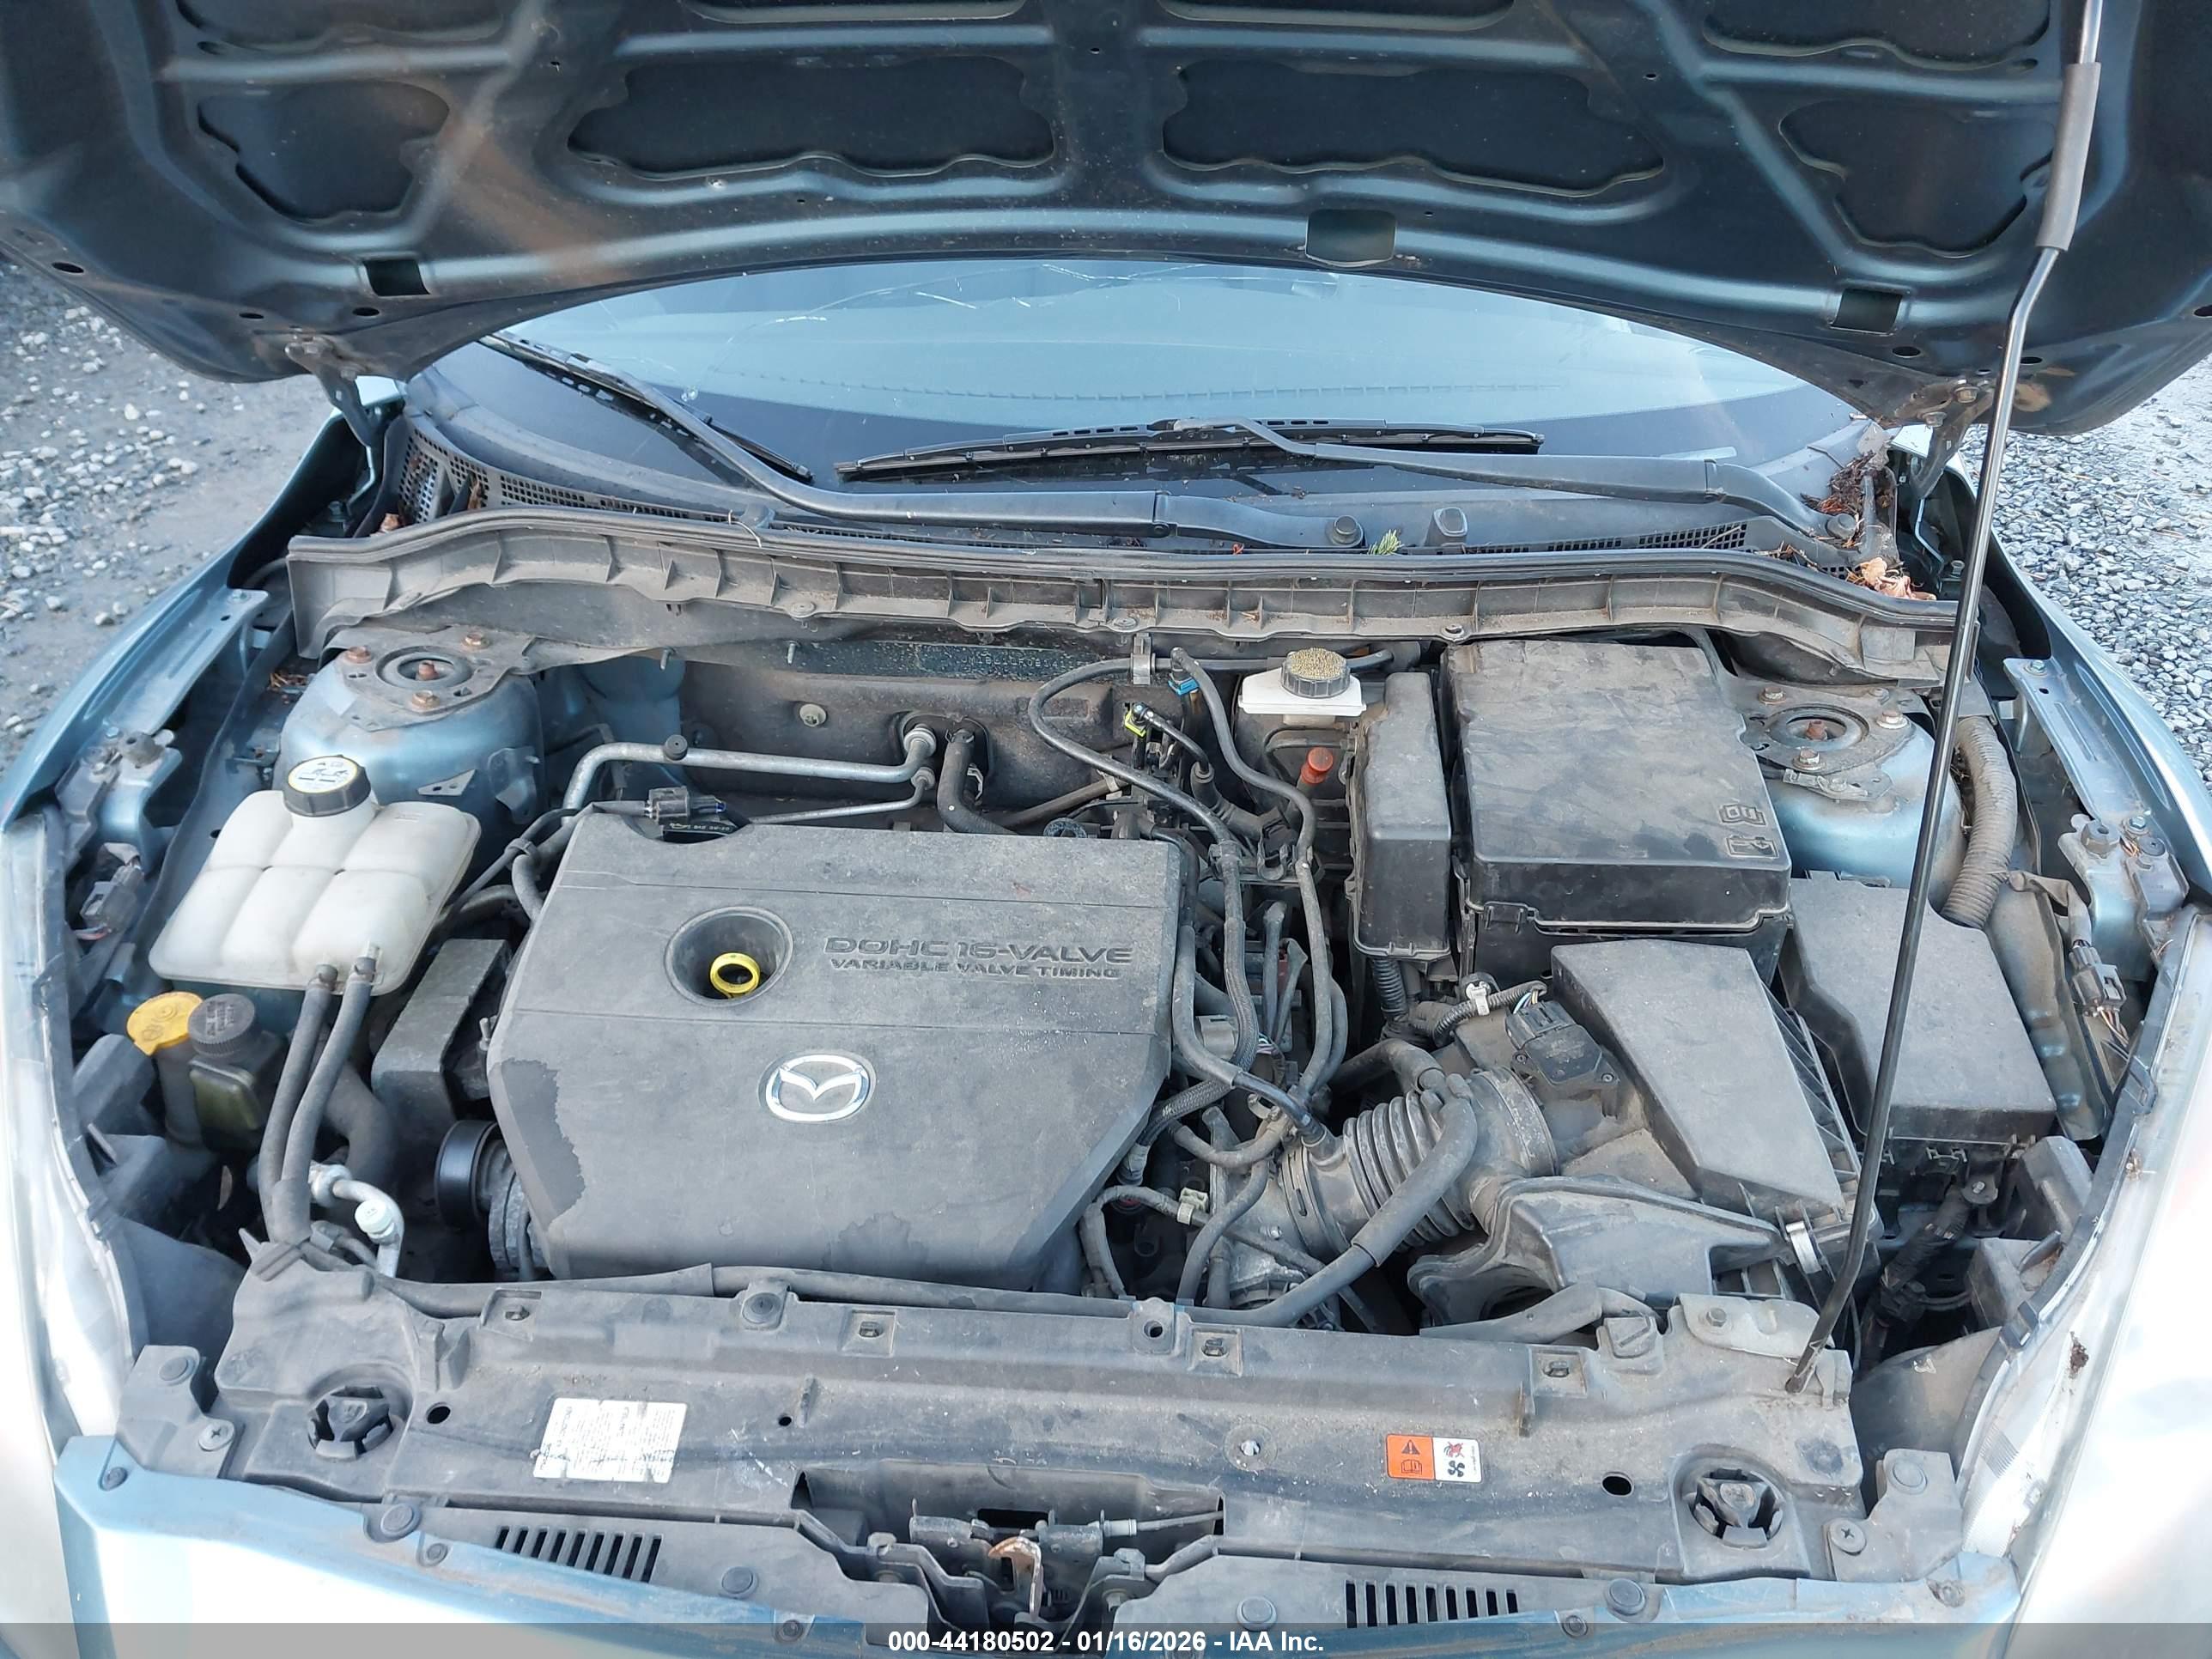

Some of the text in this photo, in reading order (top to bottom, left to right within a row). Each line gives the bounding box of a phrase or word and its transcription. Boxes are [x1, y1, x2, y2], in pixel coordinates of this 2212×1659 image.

[824, 937, 1133, 964] DOHC 16-VALVE
[830, 958, 1121, 979] VARIABLE VALVE TIMING
